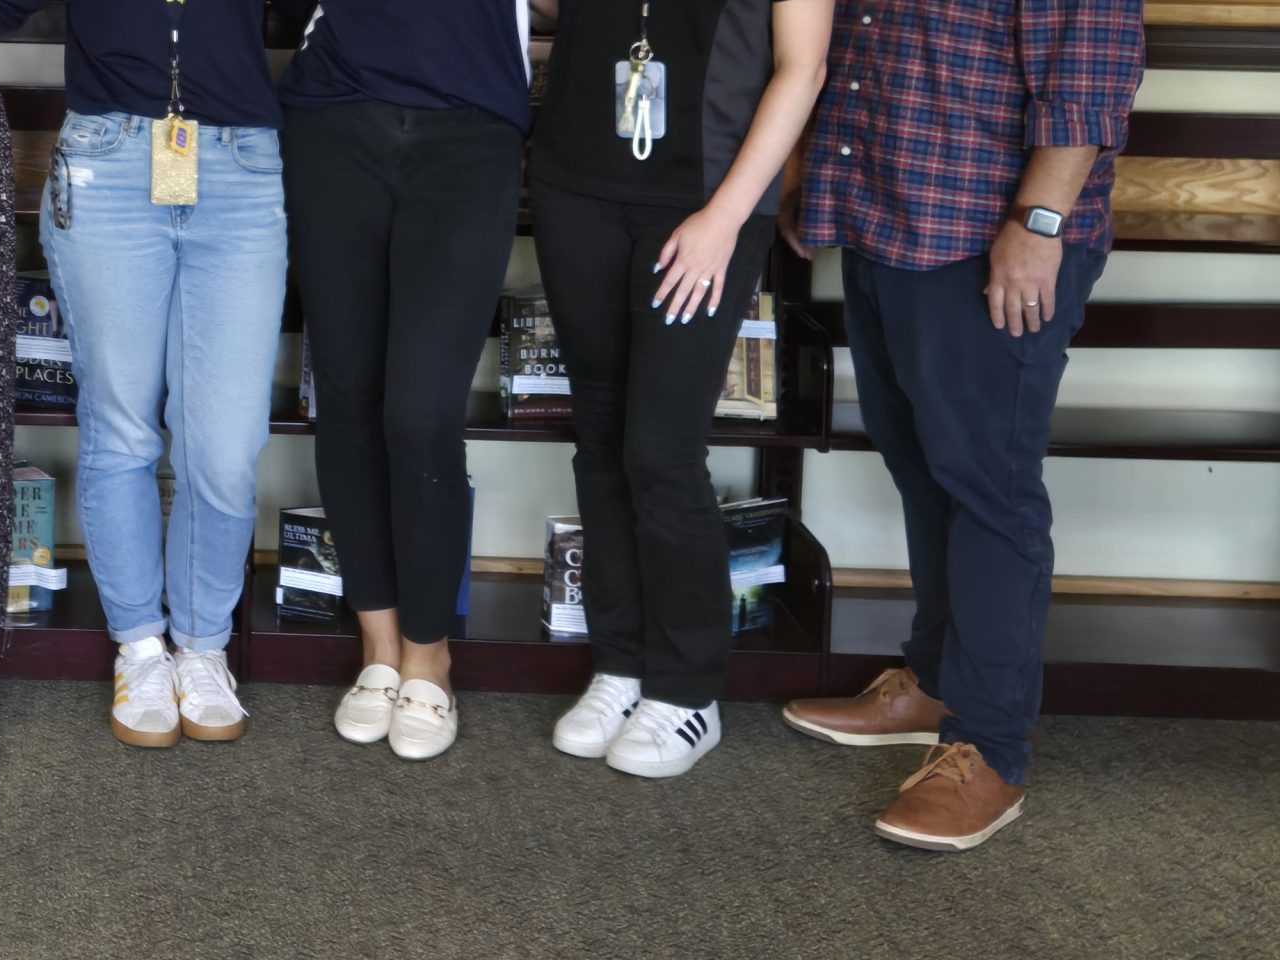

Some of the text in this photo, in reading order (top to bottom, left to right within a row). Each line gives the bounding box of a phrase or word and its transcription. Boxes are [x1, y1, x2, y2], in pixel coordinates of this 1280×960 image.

[15, 366, 74, 384] PLACES
[284, 524, 306, 533] BLESS
[283, 531, 317, 542] ULTIMA
